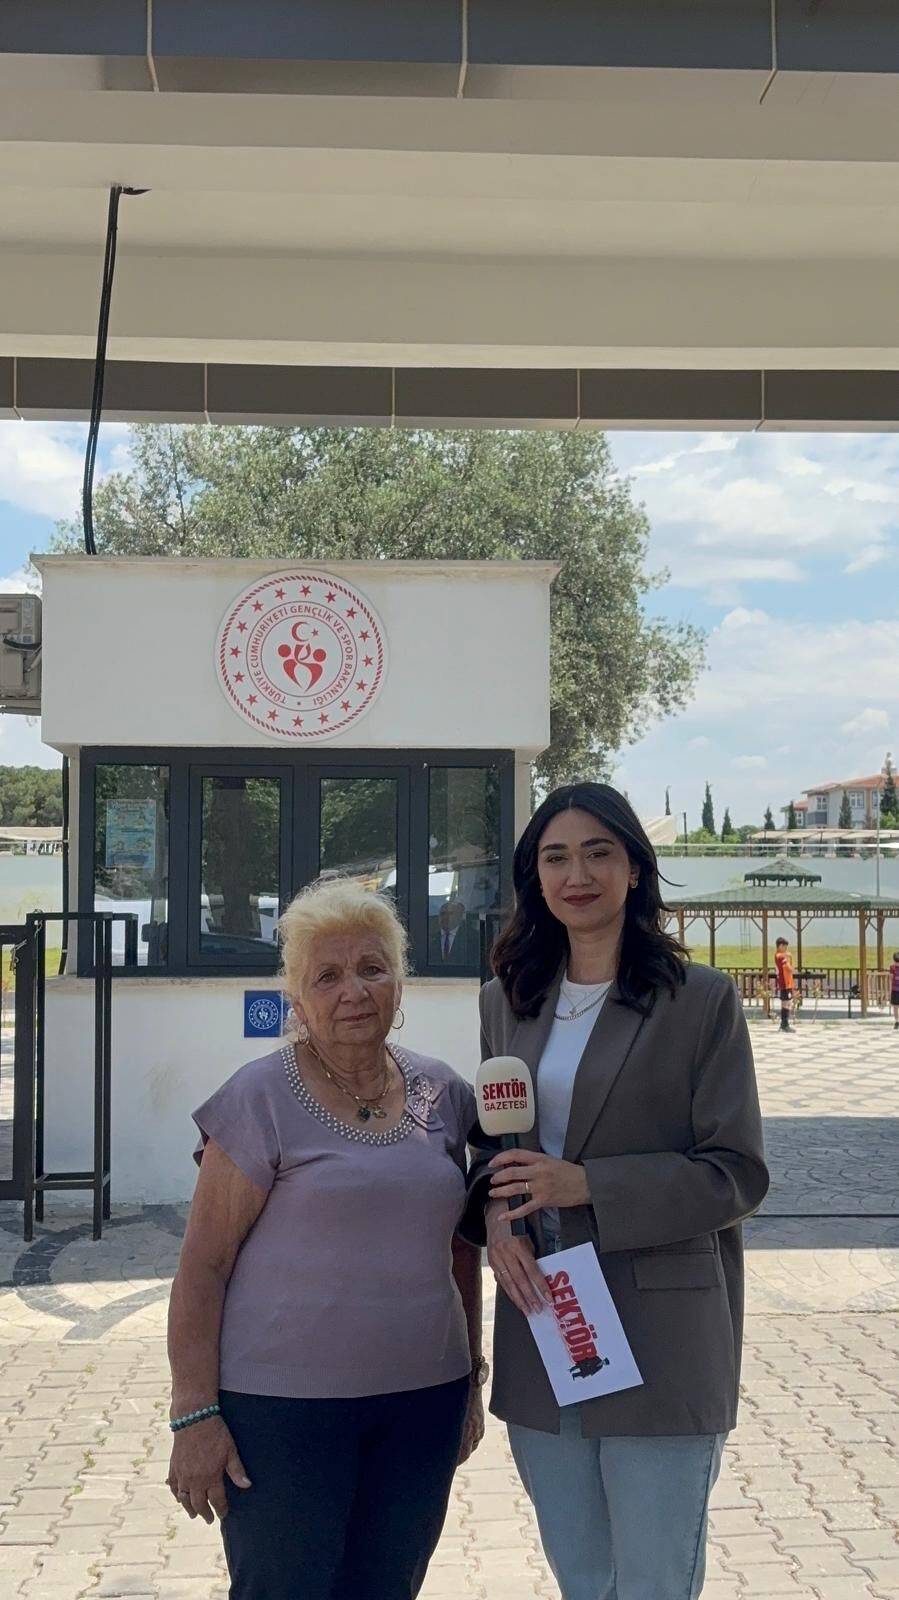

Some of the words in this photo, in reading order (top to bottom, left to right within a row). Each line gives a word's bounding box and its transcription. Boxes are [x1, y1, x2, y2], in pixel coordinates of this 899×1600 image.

[290, 605, 333, 622] GENÇLİK
[333, 620, 344, 633] VE
[250, 607, 288, 668] CUMHURİYETİ
[341, 633, 353, 661] SPOR
[253, 669, 286, 704] TÜRKİYE
[313, 664, 353, 706] BAKANLIĞI
[482, 1078, 527, 1100] SEKTÖR
[484, 1099, 528, 1111] GAZETESİ
[544, 1270, 598, 1363] SEKTÖR
